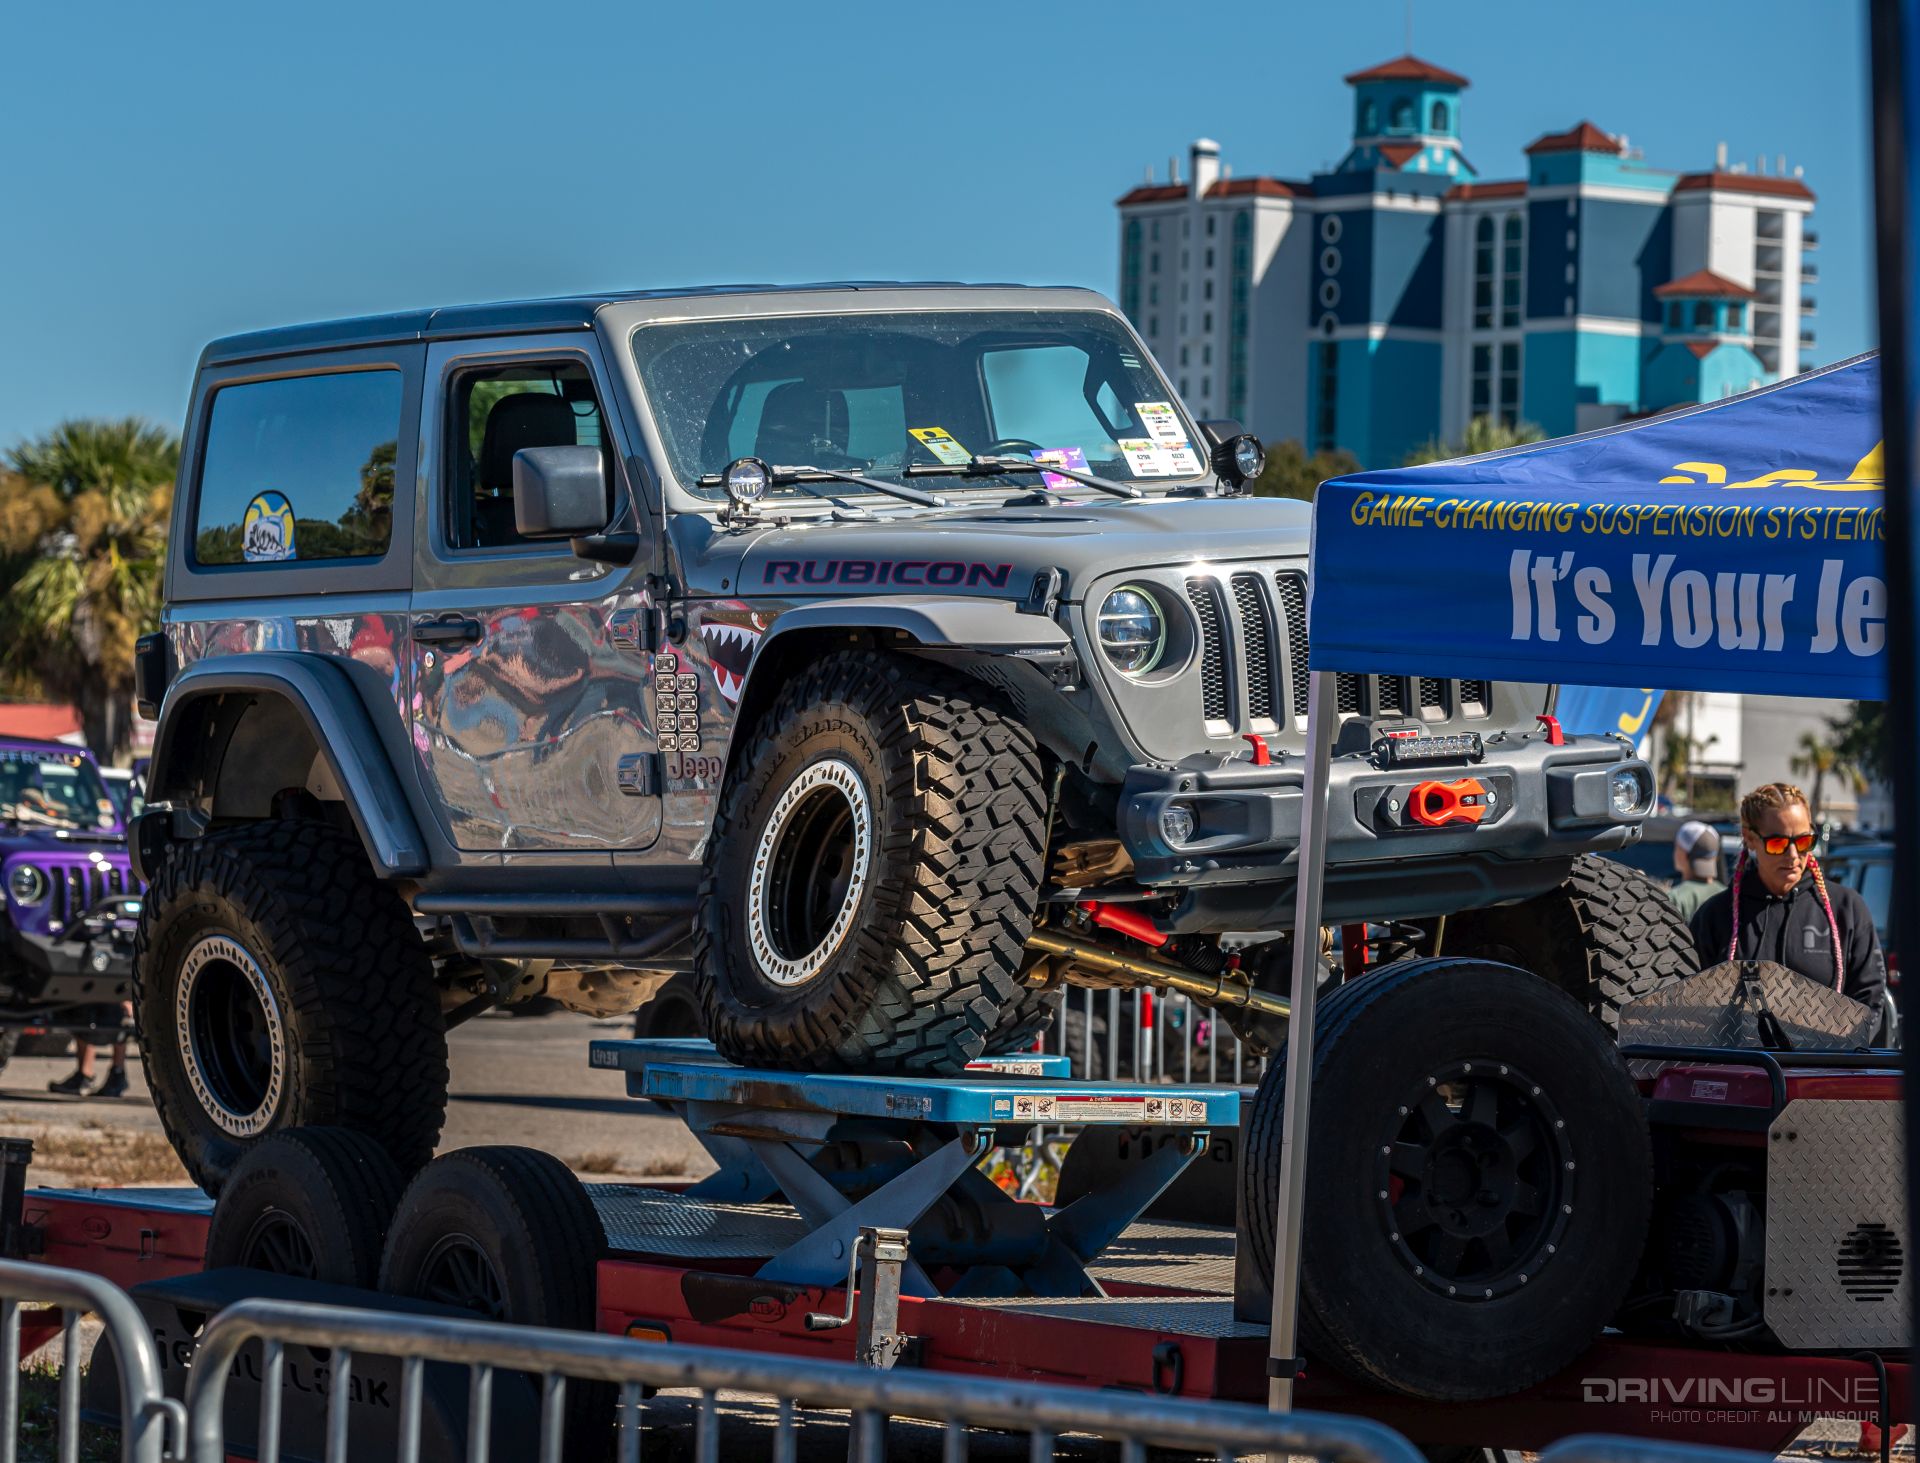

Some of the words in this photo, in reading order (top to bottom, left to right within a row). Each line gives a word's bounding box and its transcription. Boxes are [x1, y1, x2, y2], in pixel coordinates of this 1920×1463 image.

[1351, 491, 1580, 533] GAME-CHANGING
[1581, 503, 1764, 538] SUSPENSION
[762, 560, 1013, 588] RUBICON
[1509, 549, 1616, 645] It's
[1631, 553, 1797, 652] Your
[670, 750, 722, 785] Jeep
